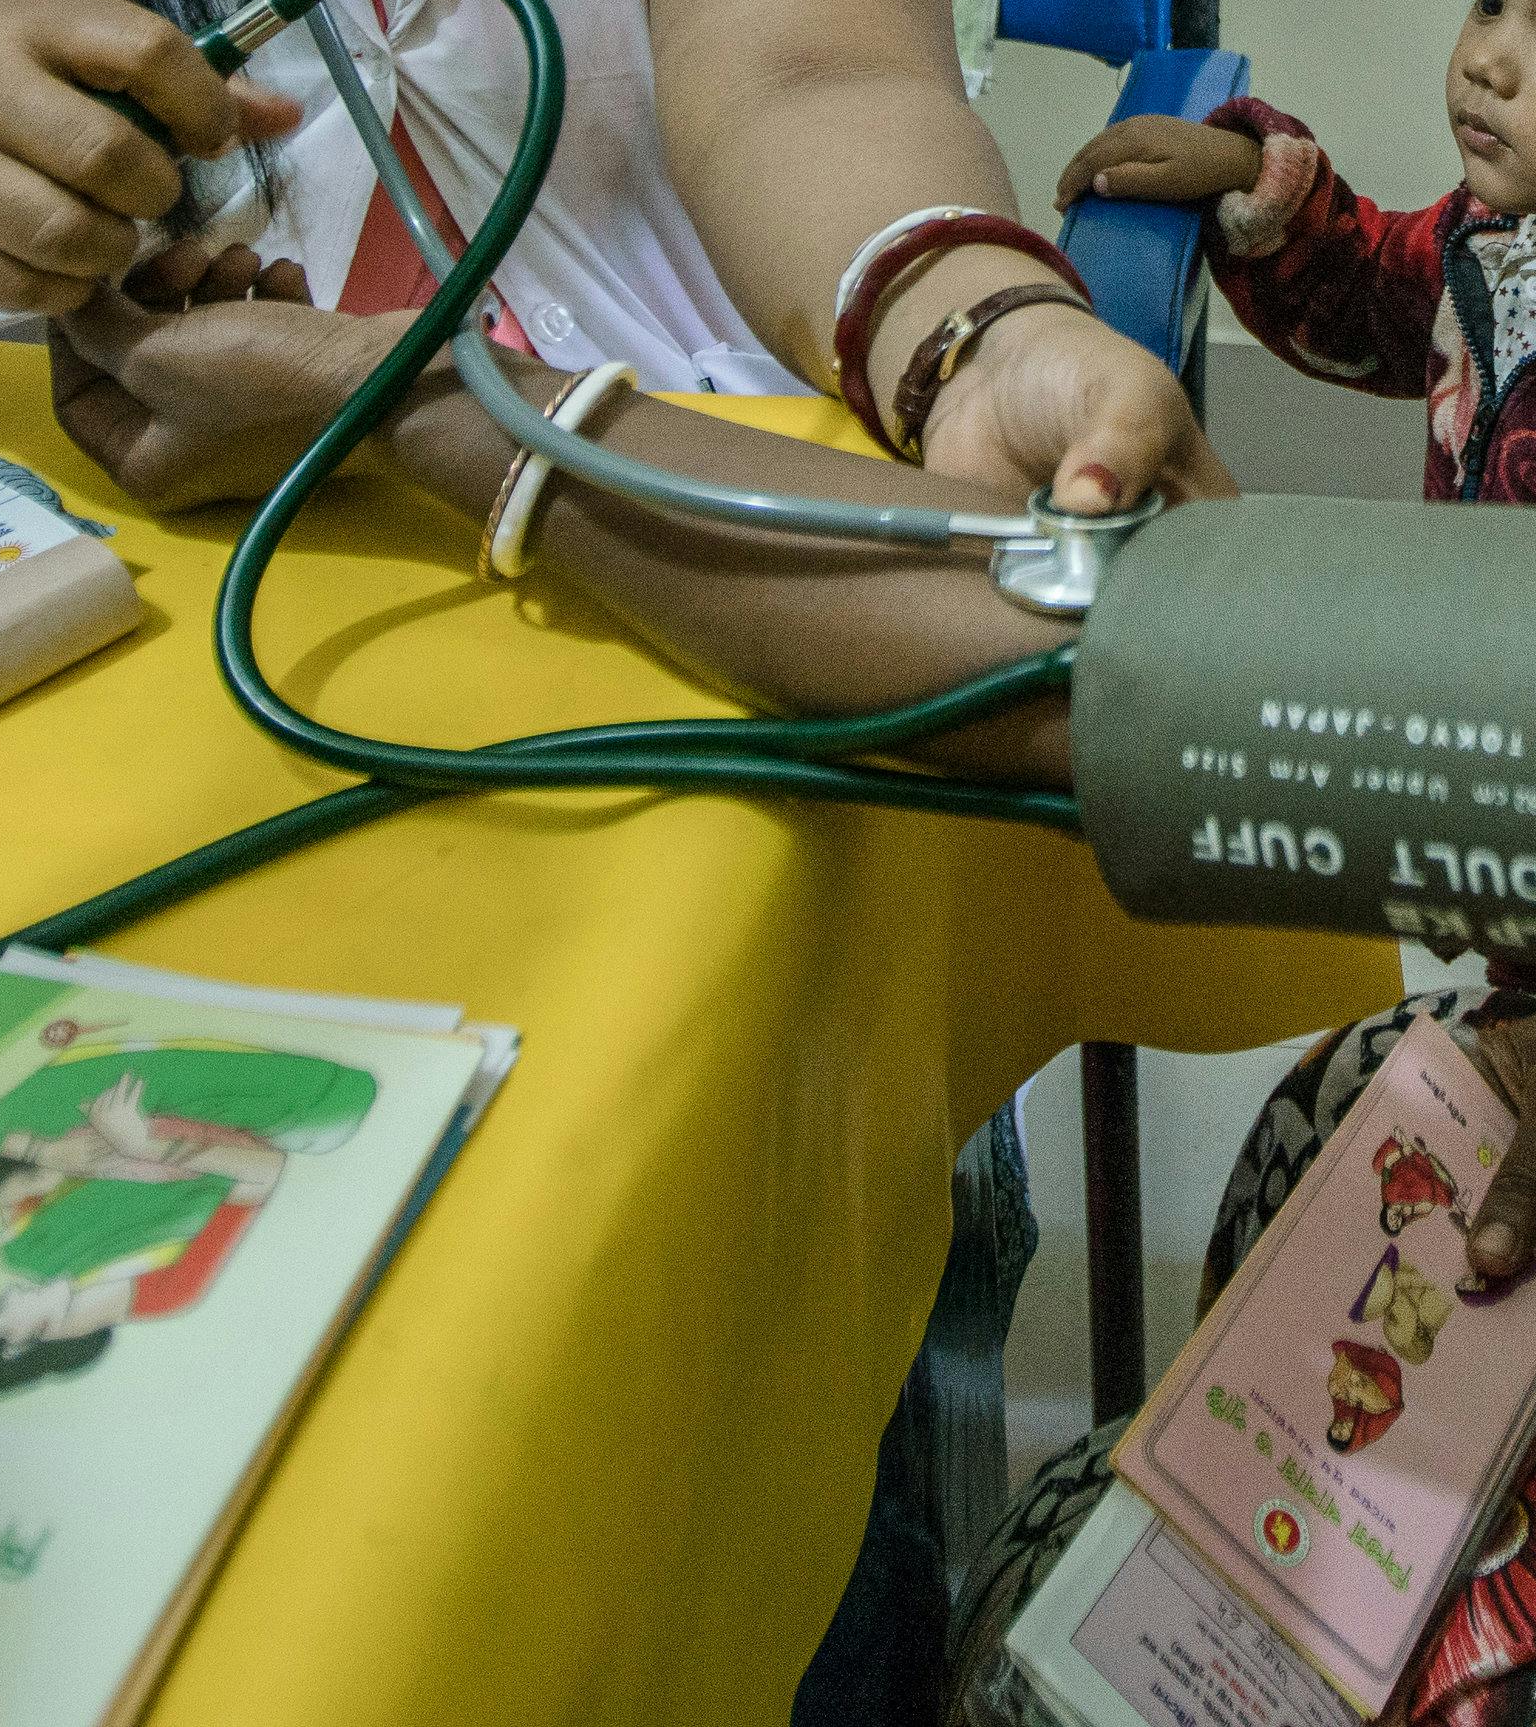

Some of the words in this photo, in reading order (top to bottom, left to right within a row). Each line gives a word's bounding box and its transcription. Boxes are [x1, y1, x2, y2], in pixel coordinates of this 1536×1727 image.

[1182, 746, 1246, 778] Size
[1269, 759, 1330, 788] Arm
[1352, 767, 1448, 801] Upper
[1193, 815, 1343, 874] CUFF
